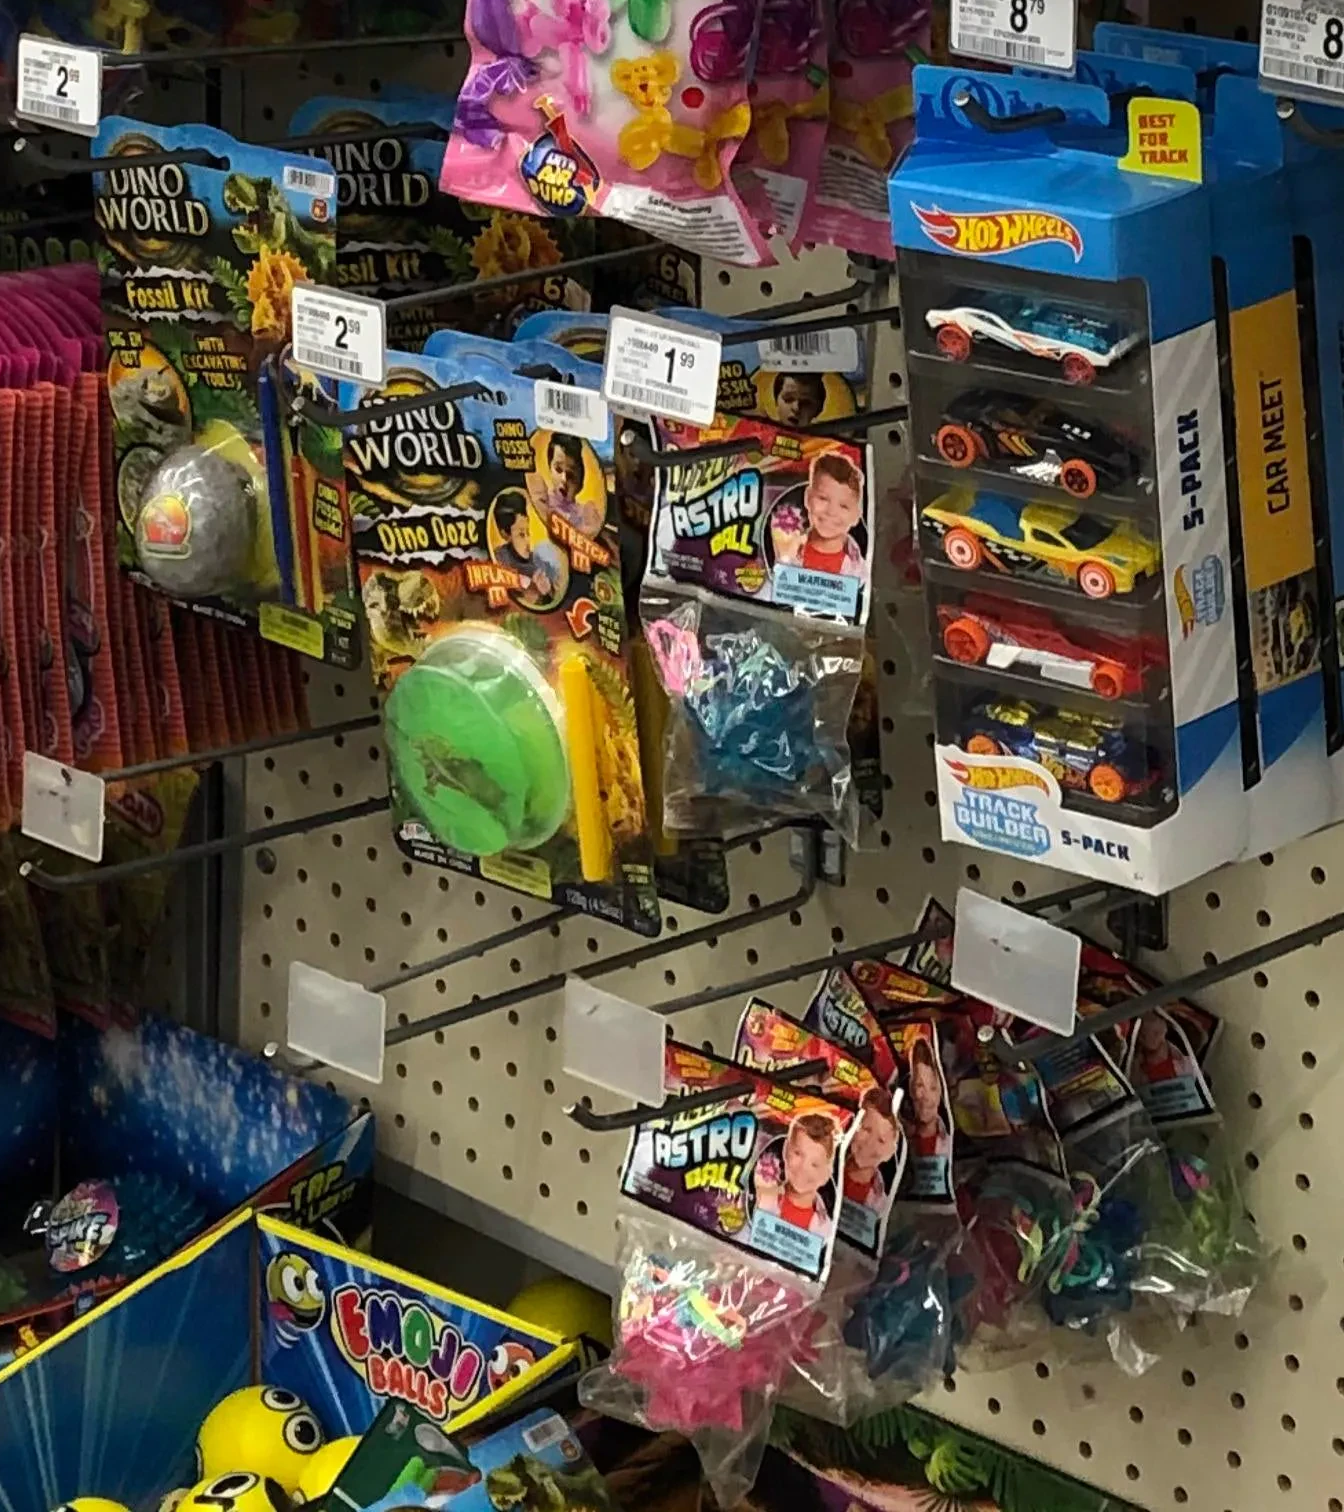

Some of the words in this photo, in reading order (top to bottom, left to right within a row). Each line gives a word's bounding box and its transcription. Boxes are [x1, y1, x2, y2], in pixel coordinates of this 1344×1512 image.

[1138, 114, 1175, 131] BEST
[1139, 132, 1168, 147] FOR
[1139, 148, 1189, 165] TRACK
[111, 164, 184, 199] DINO
[100, 196, 210, 236] WORLD
[126, 281, 177, 310] Fossil
[183, 284, 212, 309] Kit
[1260, 377, 1286, 454] MEET
[350, 432, 483, 472] WORLD
[1177, 408, 1204, 531] 5-PACK
[672, 472, 759, 538] ASTRO
[1265, 458, 1290, 515] CAR
[377, 520, 428, 554] Dino
[431, 516, 479, 546] Ooze
[551, 515, 610, 564] STRETCH
[710, 524, 753, 557] BALL
[960, 791, 1037, 822] TRACK
[957, 808, 1049, 847] BUILDER
[1062, 831, 1130, 862] 5-PACK
[657, 1113, 755, 1167] ASTRO
[685, 1166, 741, 1193] BALL
[337, 1287, 483, 1397] EMOJI
[370, 1358, 447, 1418] BALLS
